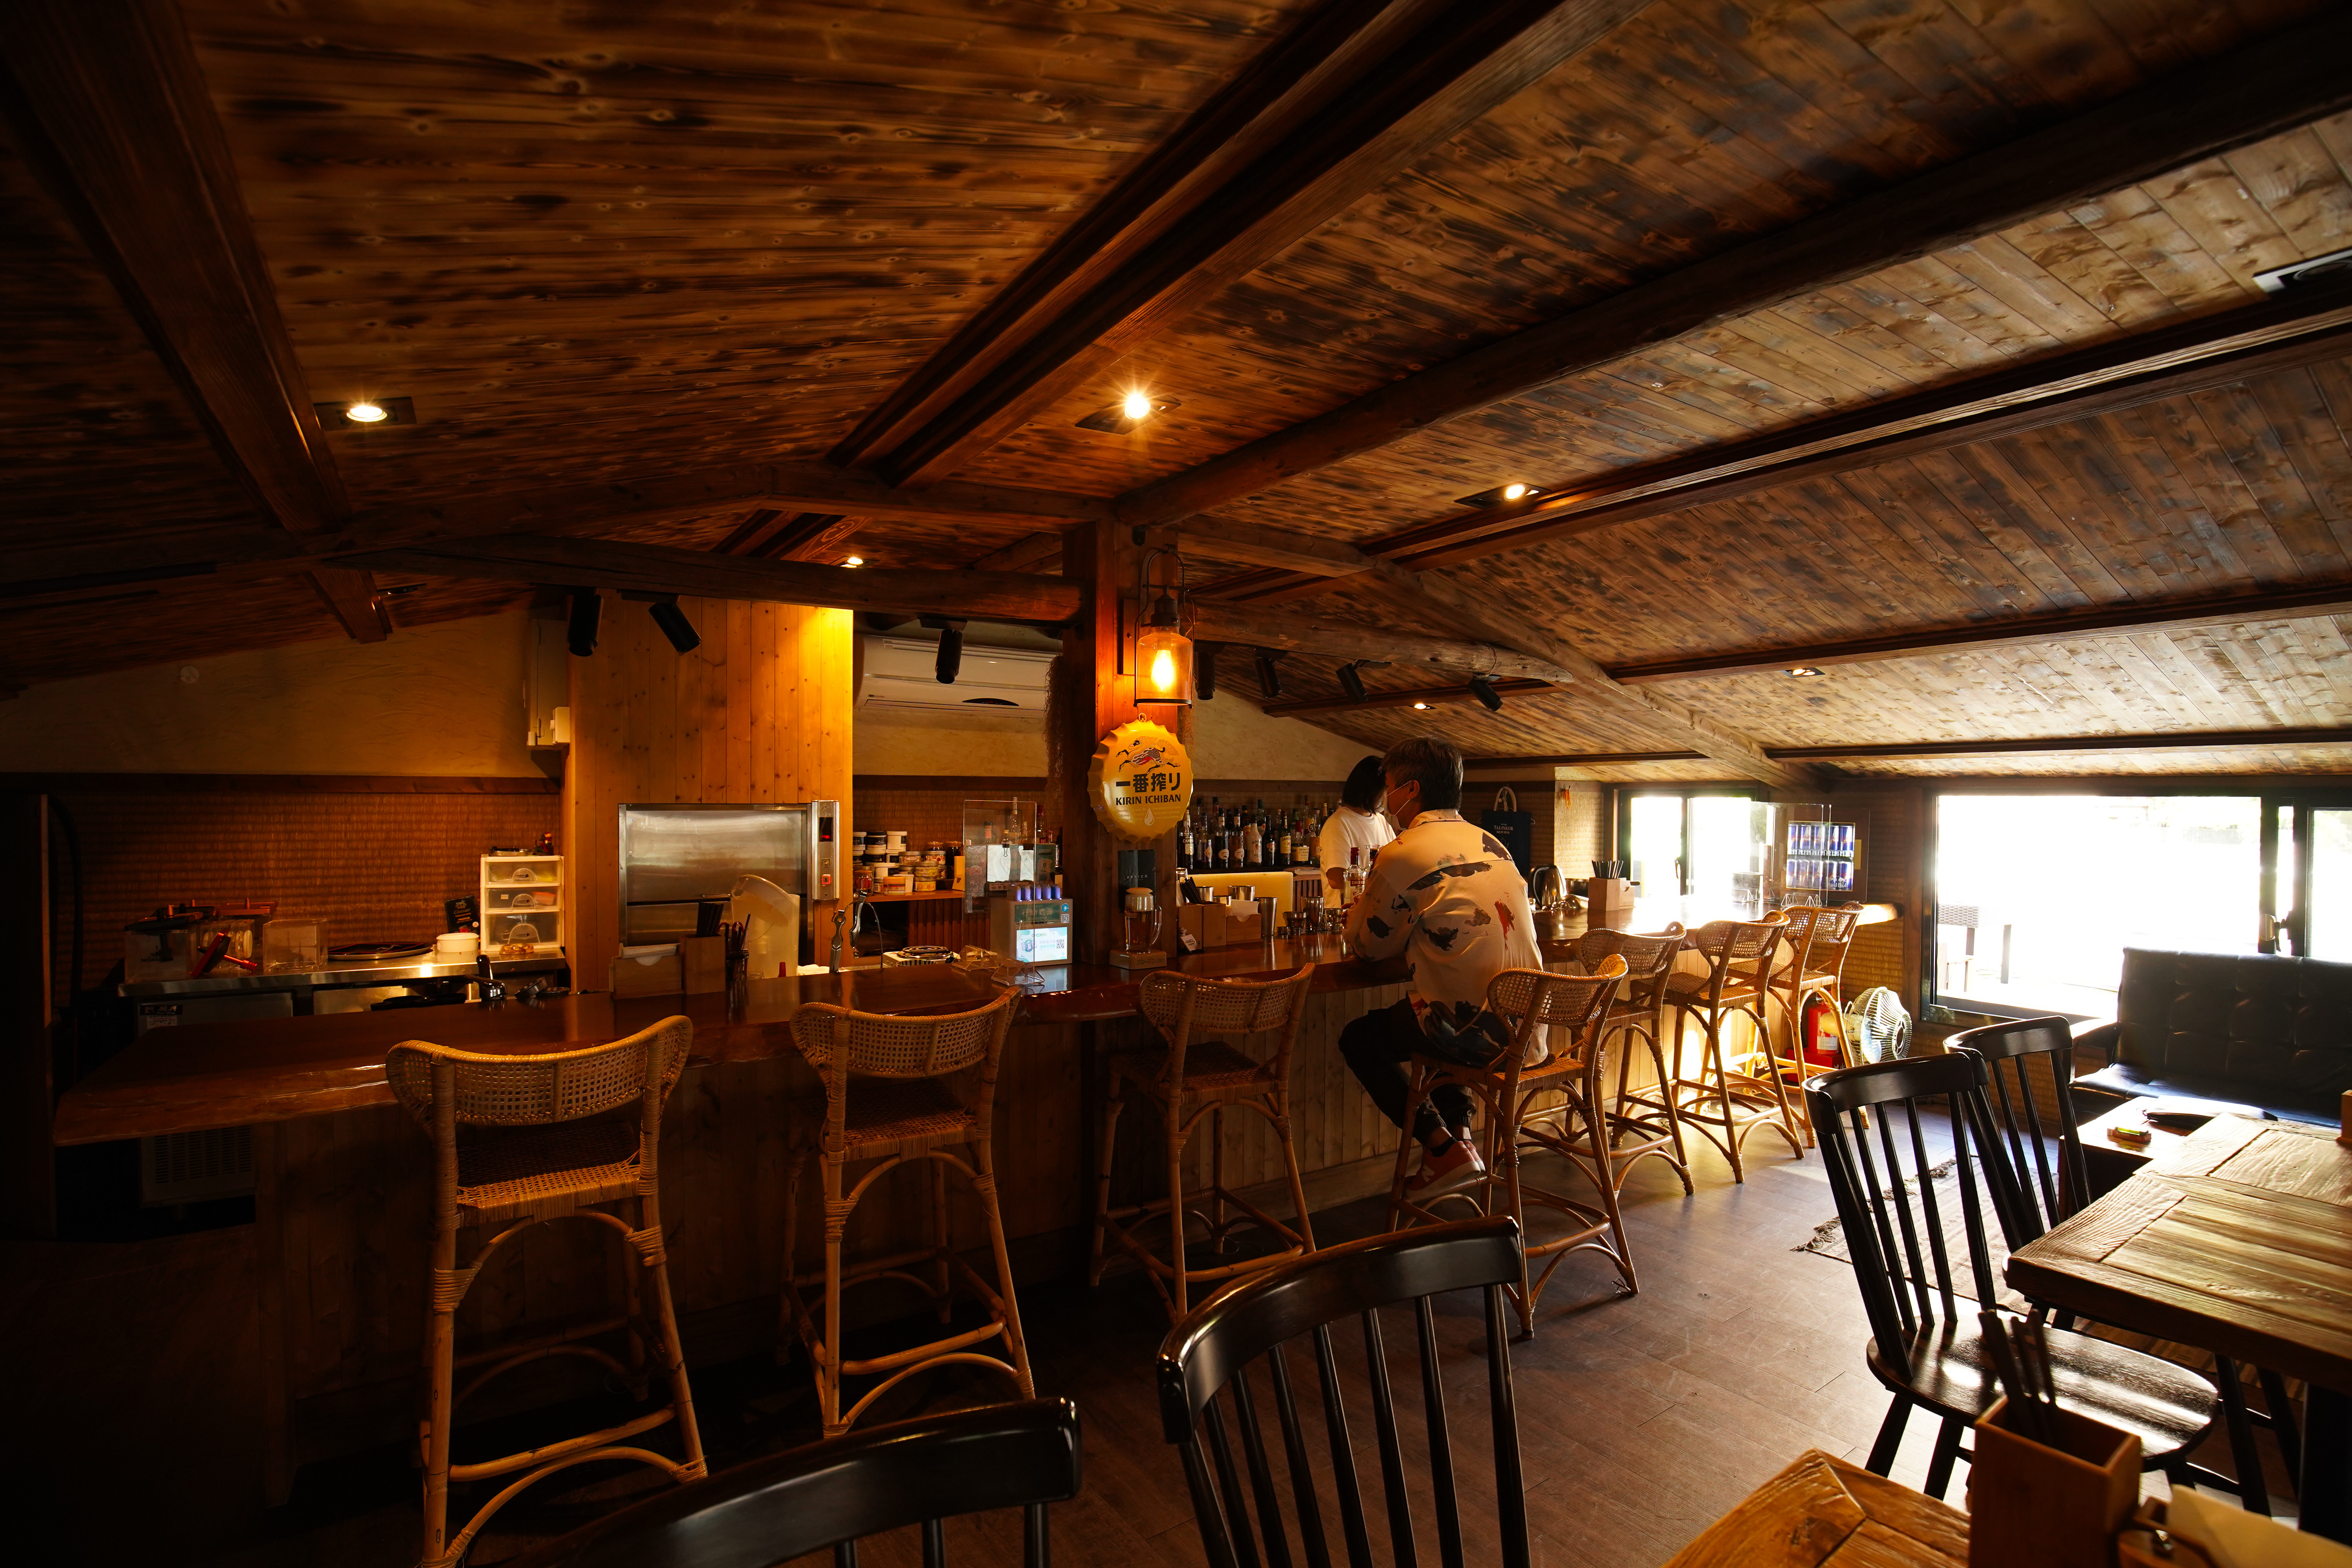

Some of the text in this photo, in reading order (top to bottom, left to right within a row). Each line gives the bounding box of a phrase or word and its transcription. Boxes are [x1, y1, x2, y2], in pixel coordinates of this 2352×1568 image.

[1116, 772, 1180, 793] 一番搾り
[1116, 794, 1181, 806] KIRIN ICHIBAN
